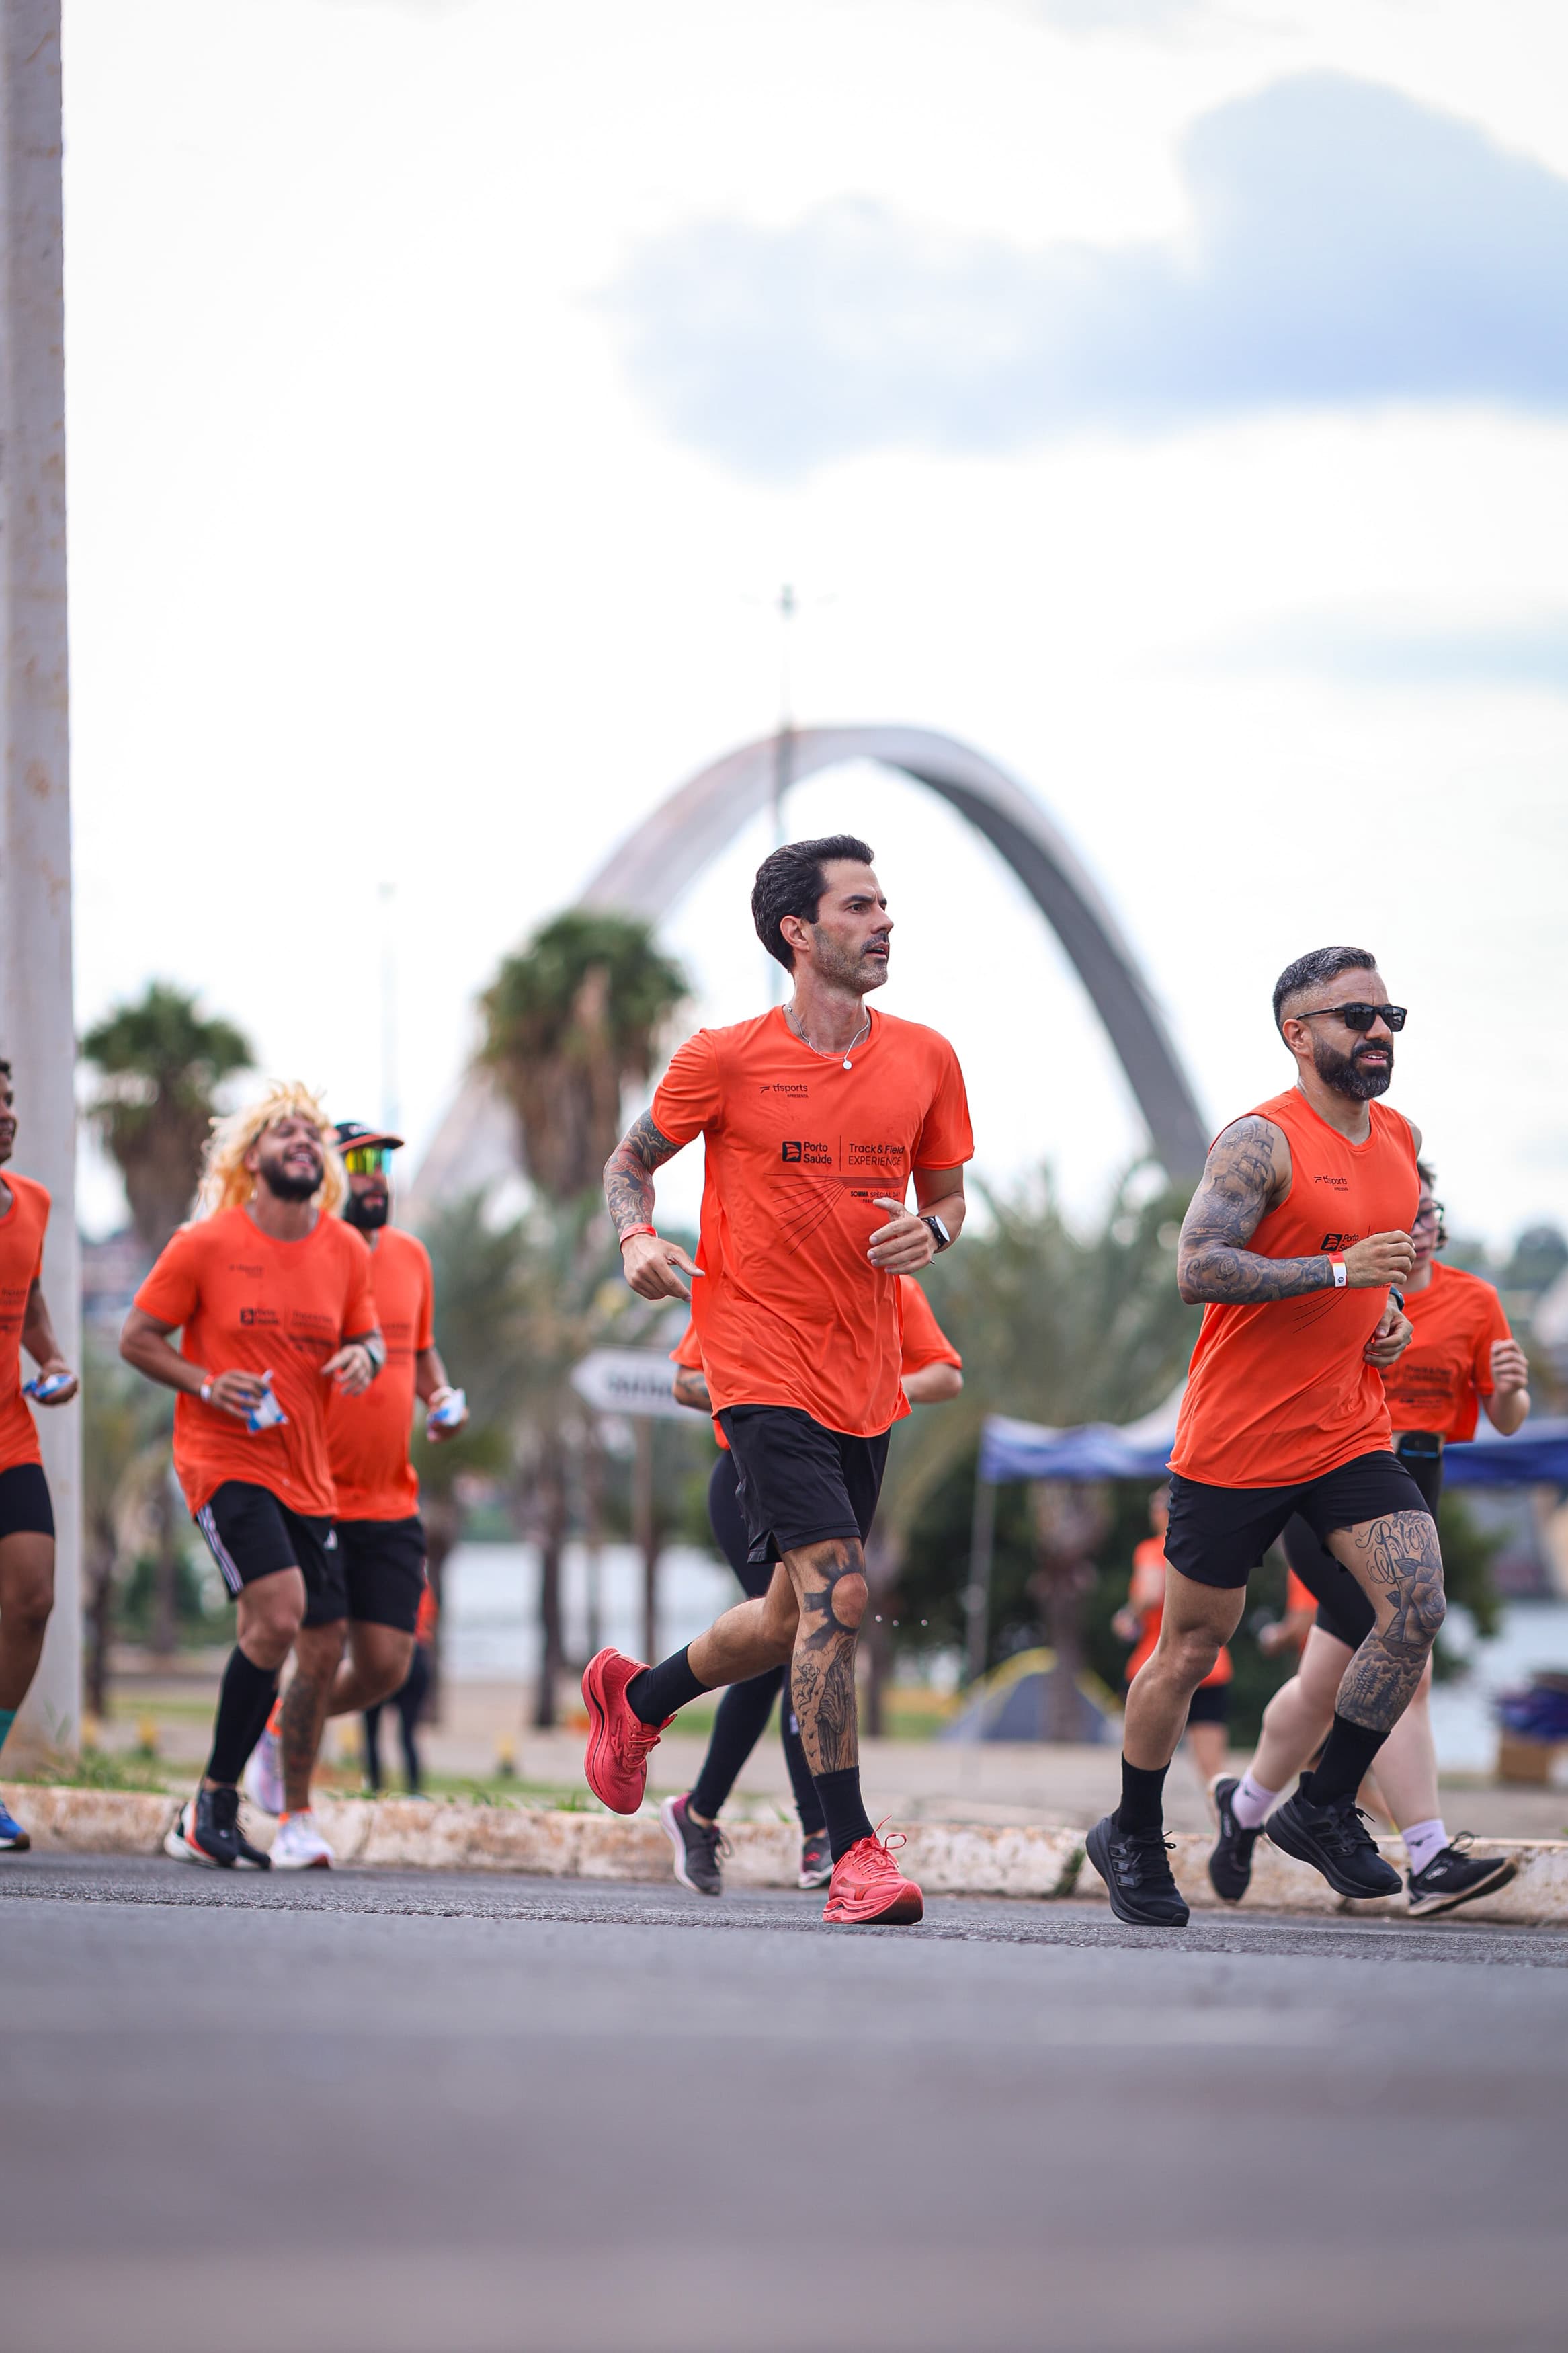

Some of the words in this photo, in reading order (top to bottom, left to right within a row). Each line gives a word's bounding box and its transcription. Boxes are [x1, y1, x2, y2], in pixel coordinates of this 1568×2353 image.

[772, 1083, 808, 1094] tfsports
[803, 1142, 828, 1152] Porto
[849, 1143, 876, 1154] Track
[876, 1144, 883, 1154] &
[884, 1145, 905, 1154] Field
[803, 1153, 833, 1164] Saúde
[848, 1155, 902, 1166] EXPERIENCE
[1323, 1175, 1348, 1186] tfsports
[1342, 1234, 1359, 1242] Porto
